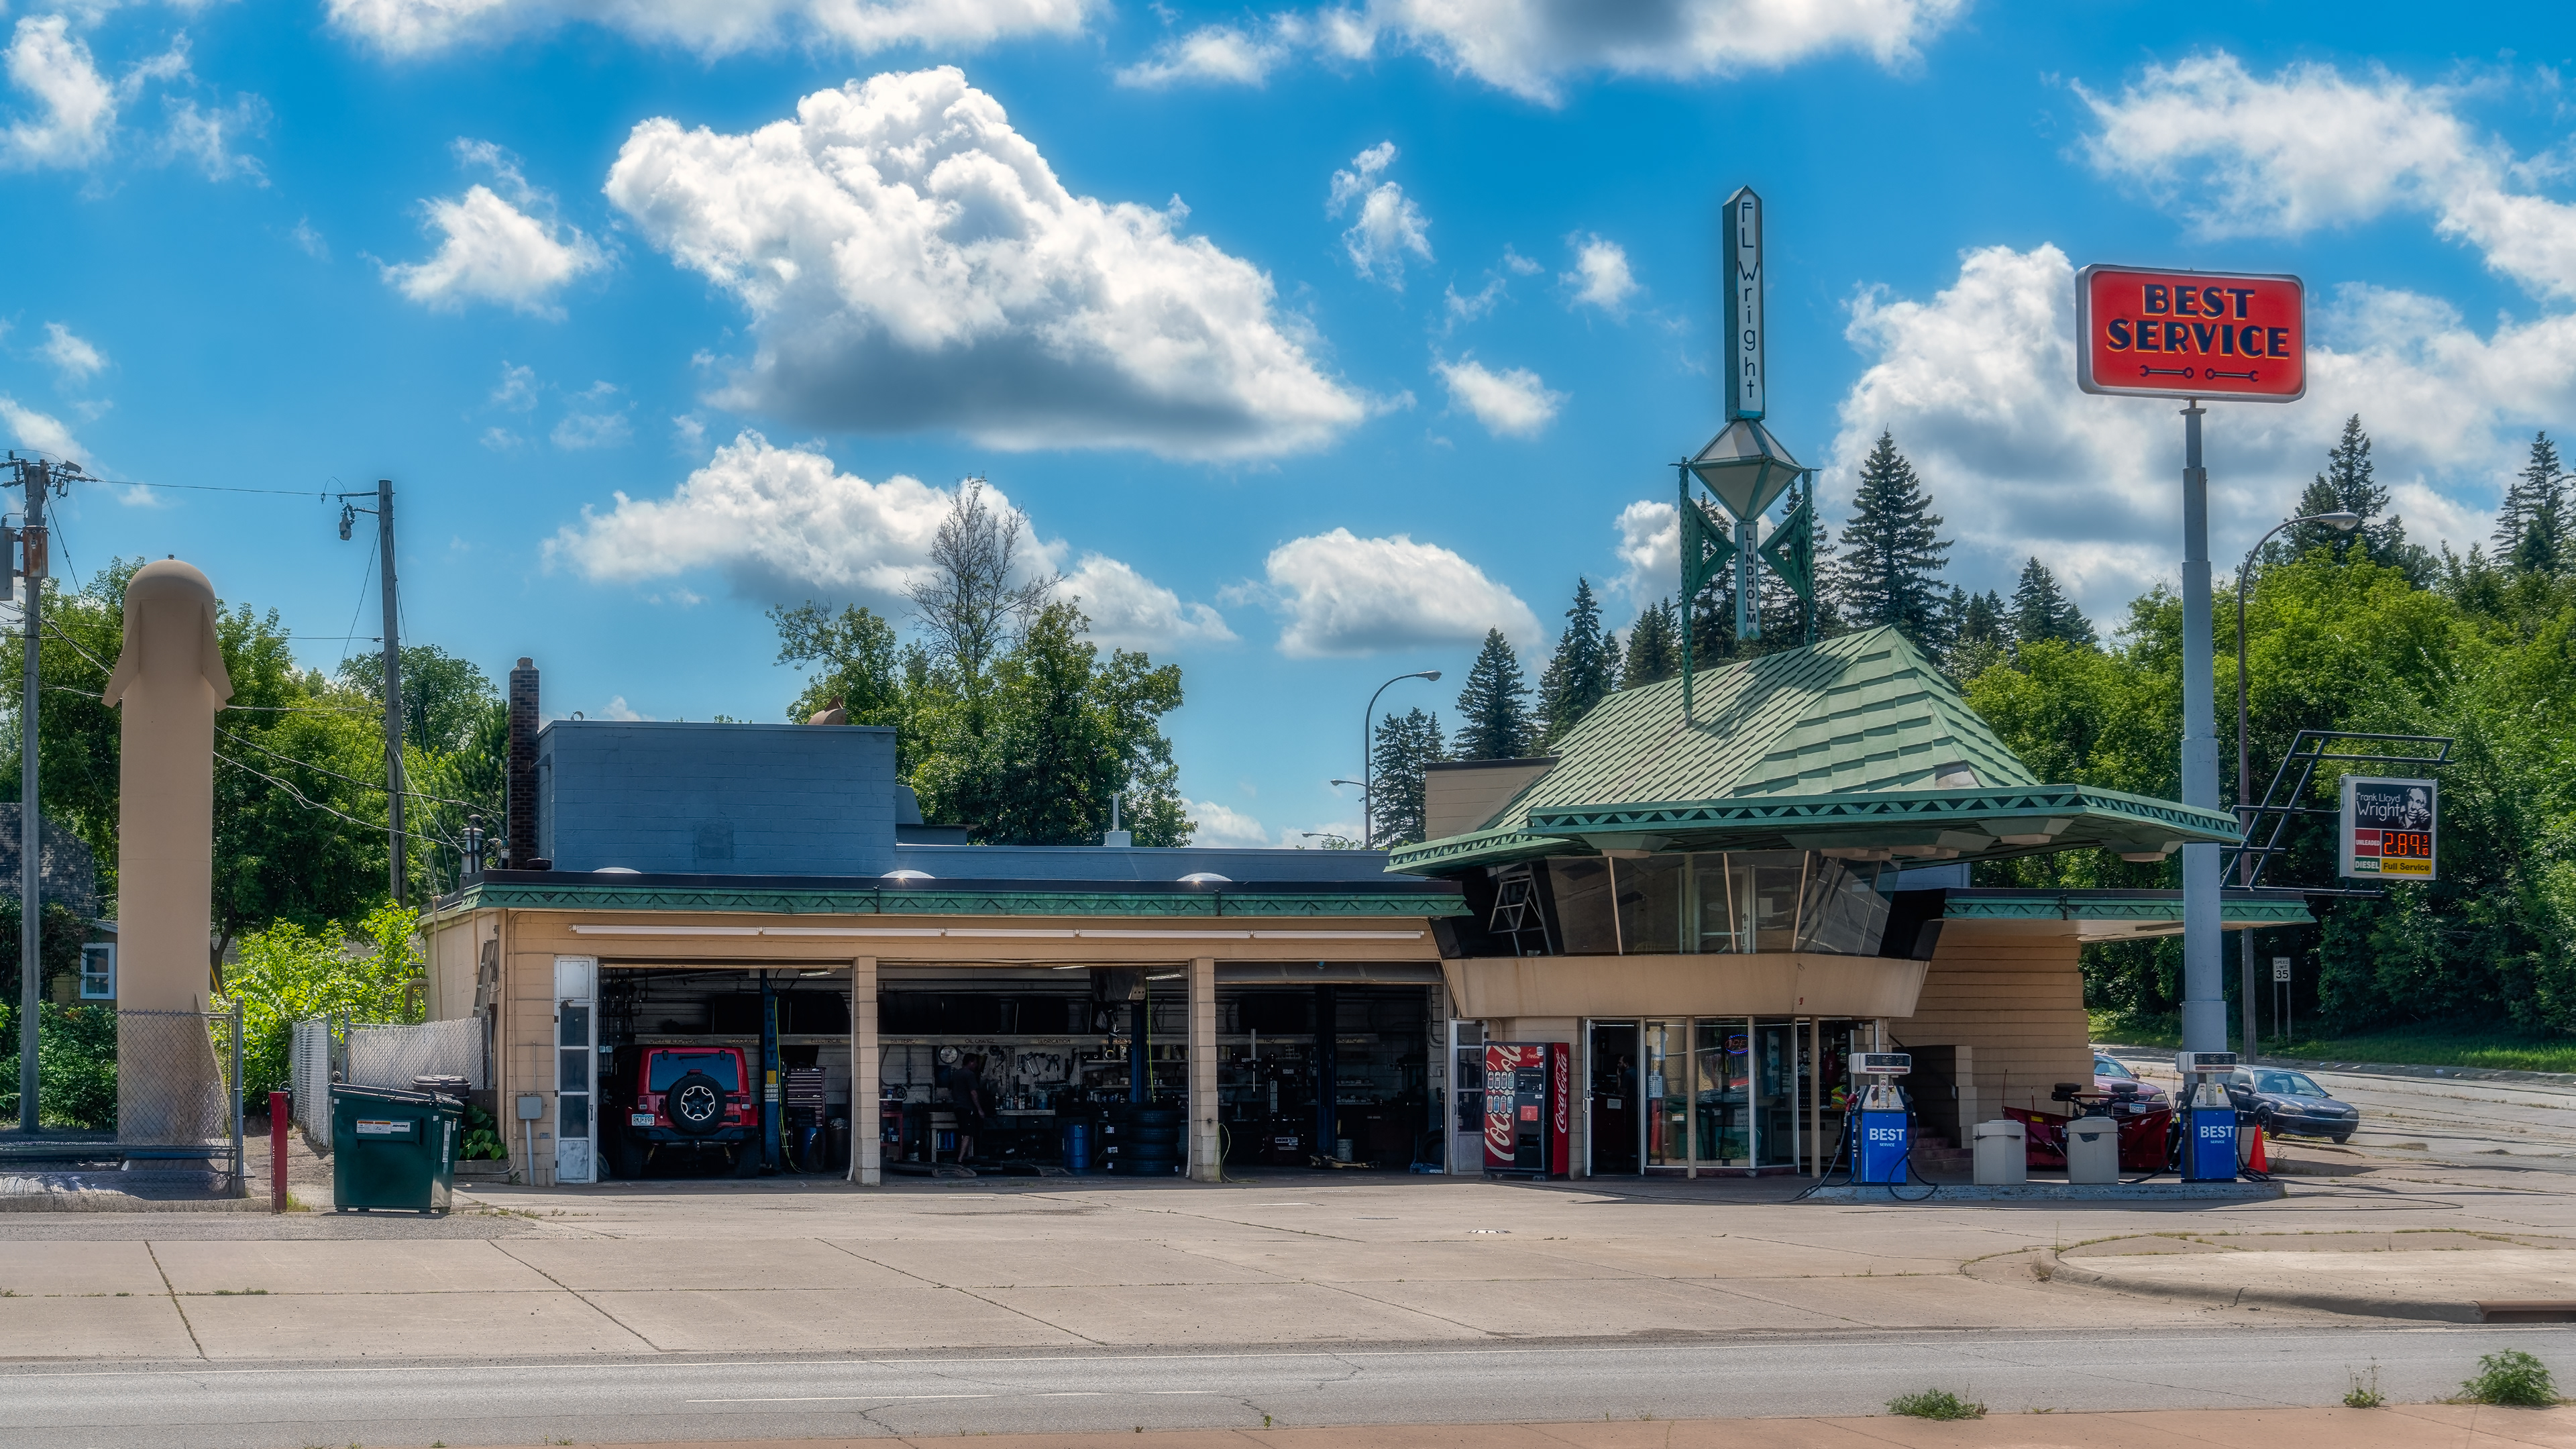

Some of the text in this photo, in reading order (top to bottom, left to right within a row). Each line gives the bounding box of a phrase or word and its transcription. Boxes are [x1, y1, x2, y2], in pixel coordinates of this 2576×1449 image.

[2142, 284, 2255, 321] BEST
[1739, 261, 1759, 398] Wright
[2106, 318, 2290, 360] SERVICE
[1746, 530, 1757, 623] LINDHOLM
[2356, 792, 2400, 805] Frank Lloyd
[2356, 801, 2400, 821] Wright
[2384, 833, 2420, 855] 2.89
[2355, 861, 2379, 869] DIESEL
[2400, 863, 2430, 871] Service
[2275, 970, 2289, 979] 35
[1556, 1048, 1567, 1134] Coca-Cola
[1869, 1128, 1905, 1141] BEST
[2200, 1126, 2234, 1138] BEST
